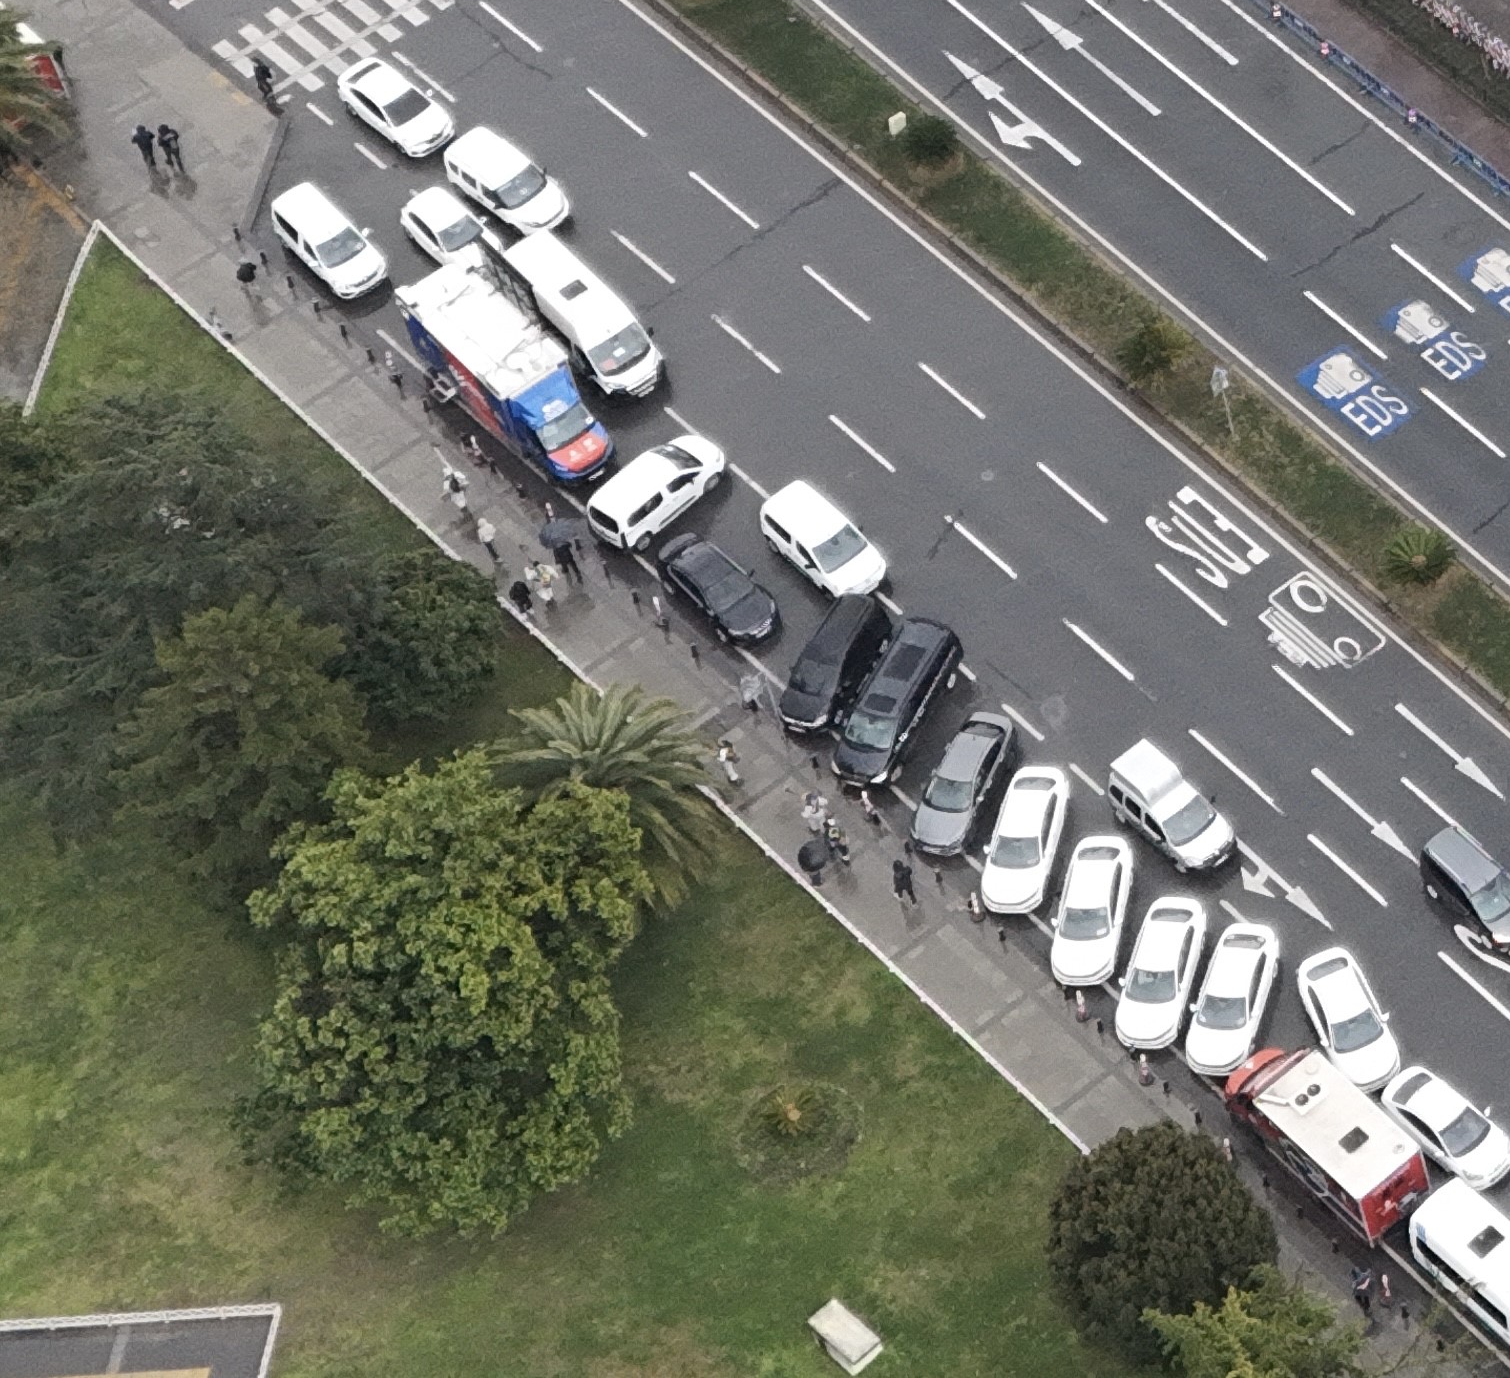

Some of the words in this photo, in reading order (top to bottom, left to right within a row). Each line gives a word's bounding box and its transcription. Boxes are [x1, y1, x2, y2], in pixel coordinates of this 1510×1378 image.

[1420, 331, 1487, 381] EDS
[1340, 385, 1409, 437] EDS
[1145, 486, 1271, 589] EDS
